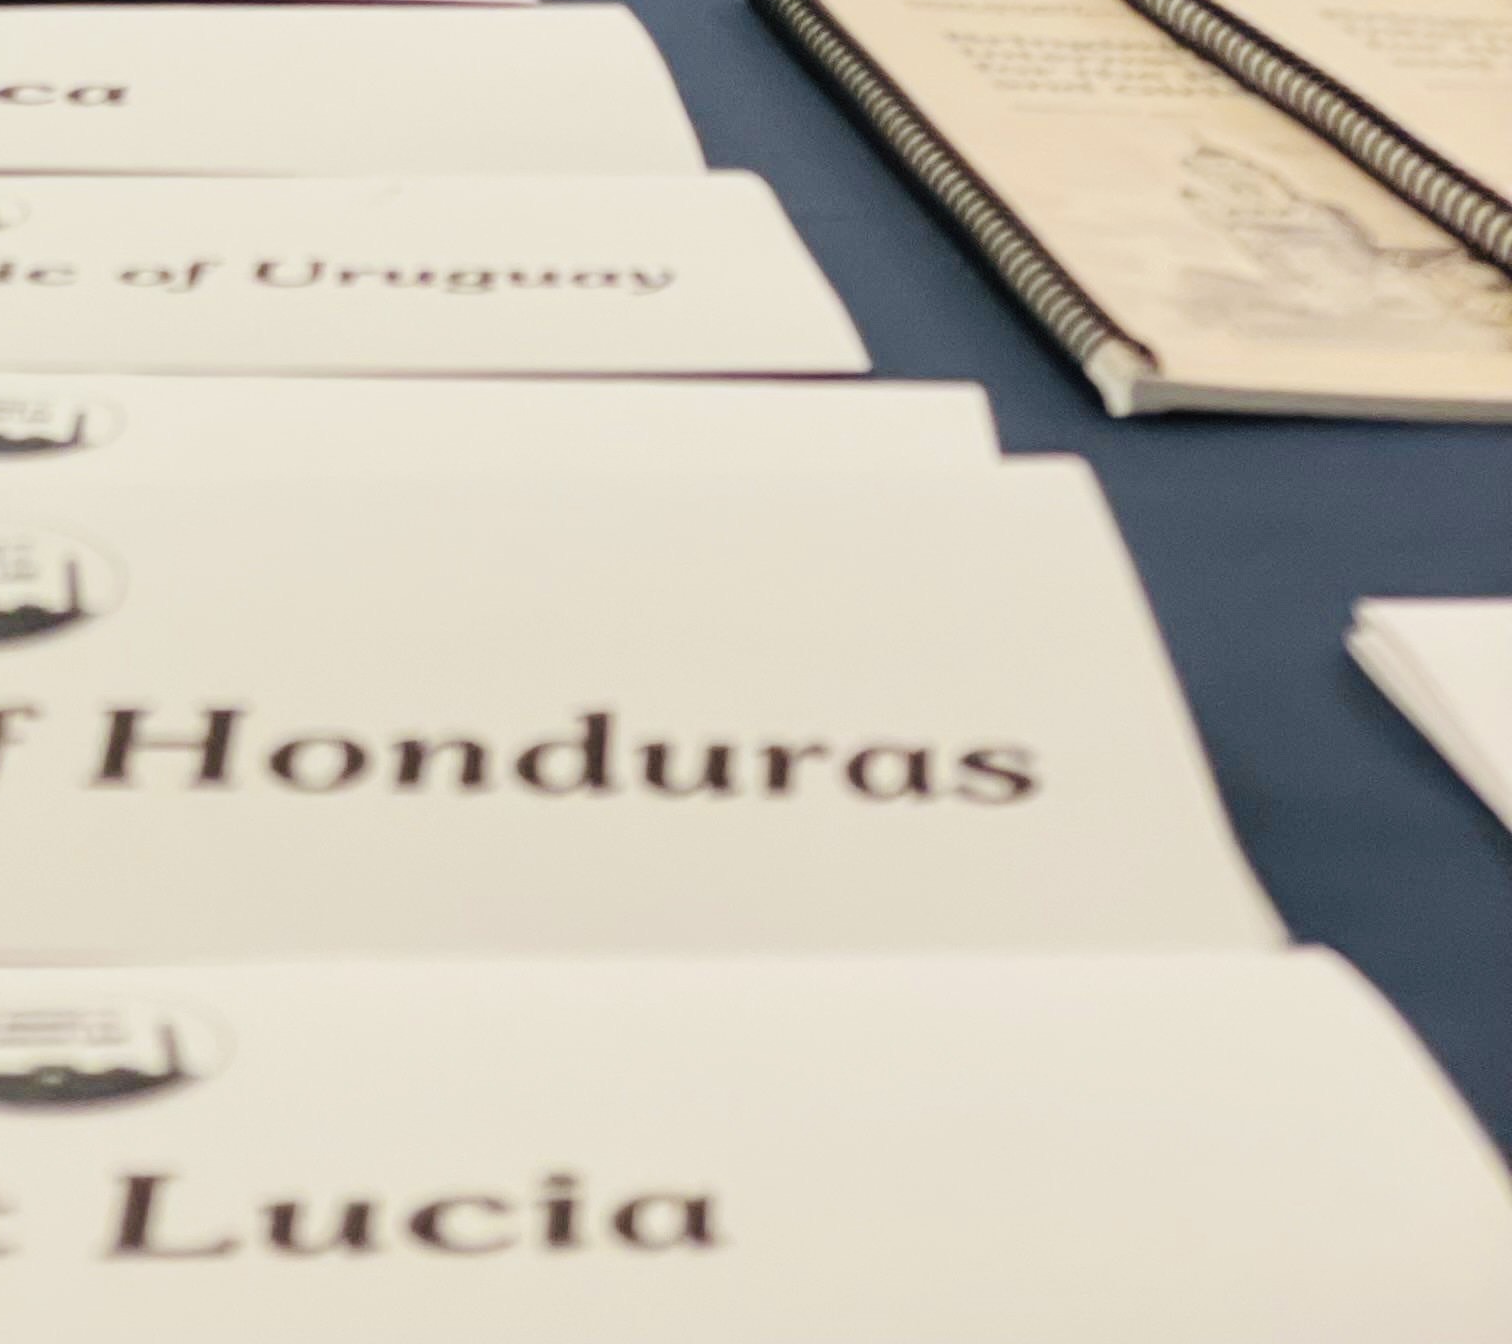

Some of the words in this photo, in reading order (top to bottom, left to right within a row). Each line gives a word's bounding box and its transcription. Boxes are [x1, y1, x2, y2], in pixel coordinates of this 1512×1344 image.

[116, 258, 220, 293] of
[251, 258, 677, 295] Uruguay
[86, 703, 1044, 807] Honduras
[99, 1168, 728, 1262] Lucia
